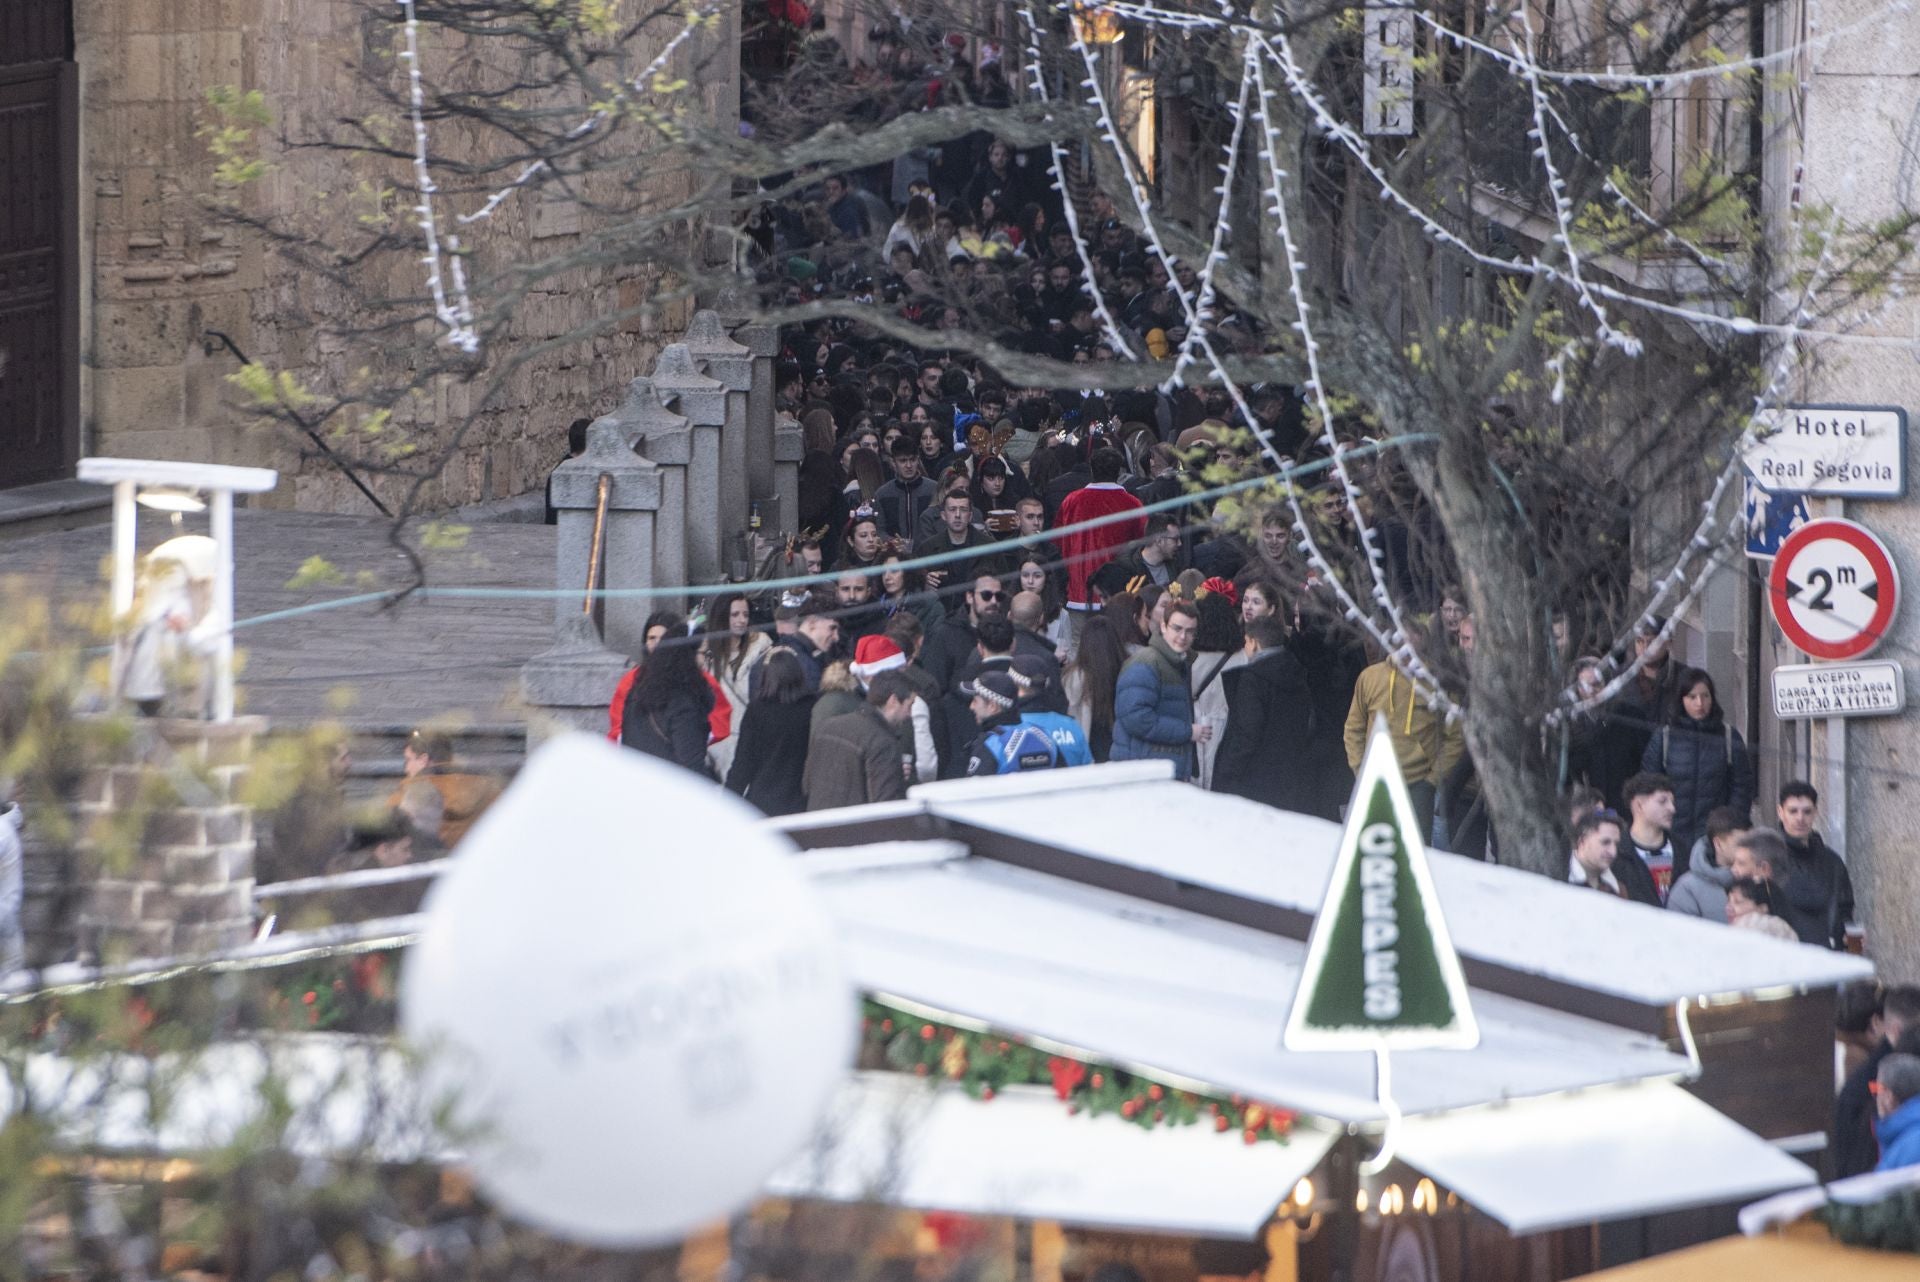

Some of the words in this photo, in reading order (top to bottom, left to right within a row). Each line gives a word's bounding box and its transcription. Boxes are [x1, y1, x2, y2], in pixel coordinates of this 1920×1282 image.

[1796, 416, 1866, 437] Hotel
[1762, 458, 1804, 477] Real
[1814, 460, 1892, 483] Segovia
[1807, 671, 1861, 684] EXCEPTO
[1778, 686, 1817, 698] CARGA
[1821, 686, 1828, 696] Y
[1832, 682, 1893, 695] DESCARGA
[1780, 700, 1795, 711] DE
[1834, 696, 1842, 708] A
[1359, 822, 1401, 1021] CREPES
